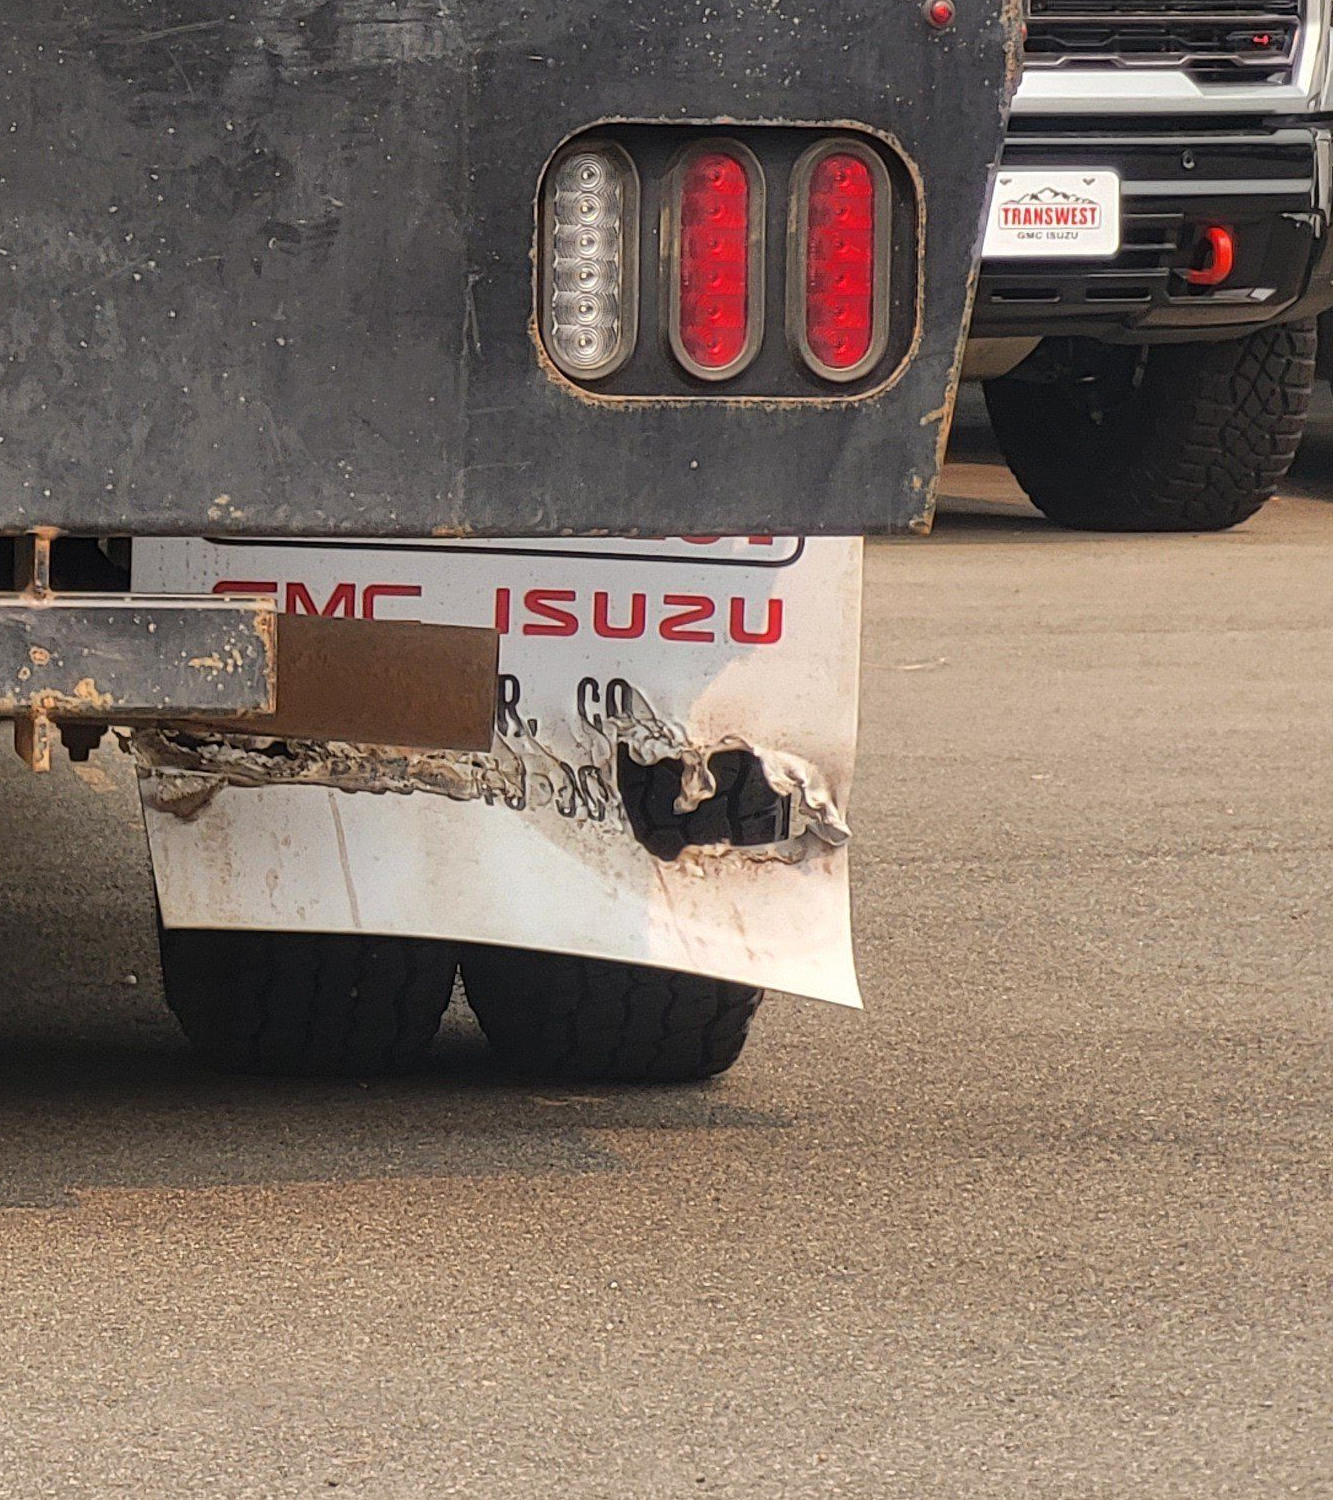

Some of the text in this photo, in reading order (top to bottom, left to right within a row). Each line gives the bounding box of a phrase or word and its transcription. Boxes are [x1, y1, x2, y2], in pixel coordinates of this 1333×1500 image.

[1002, 207, 1097, 225] TRANSWEST
[1017, 231, 1078, 240] GMC ISUZU
[494, 587, 785, 645] ISUZU
